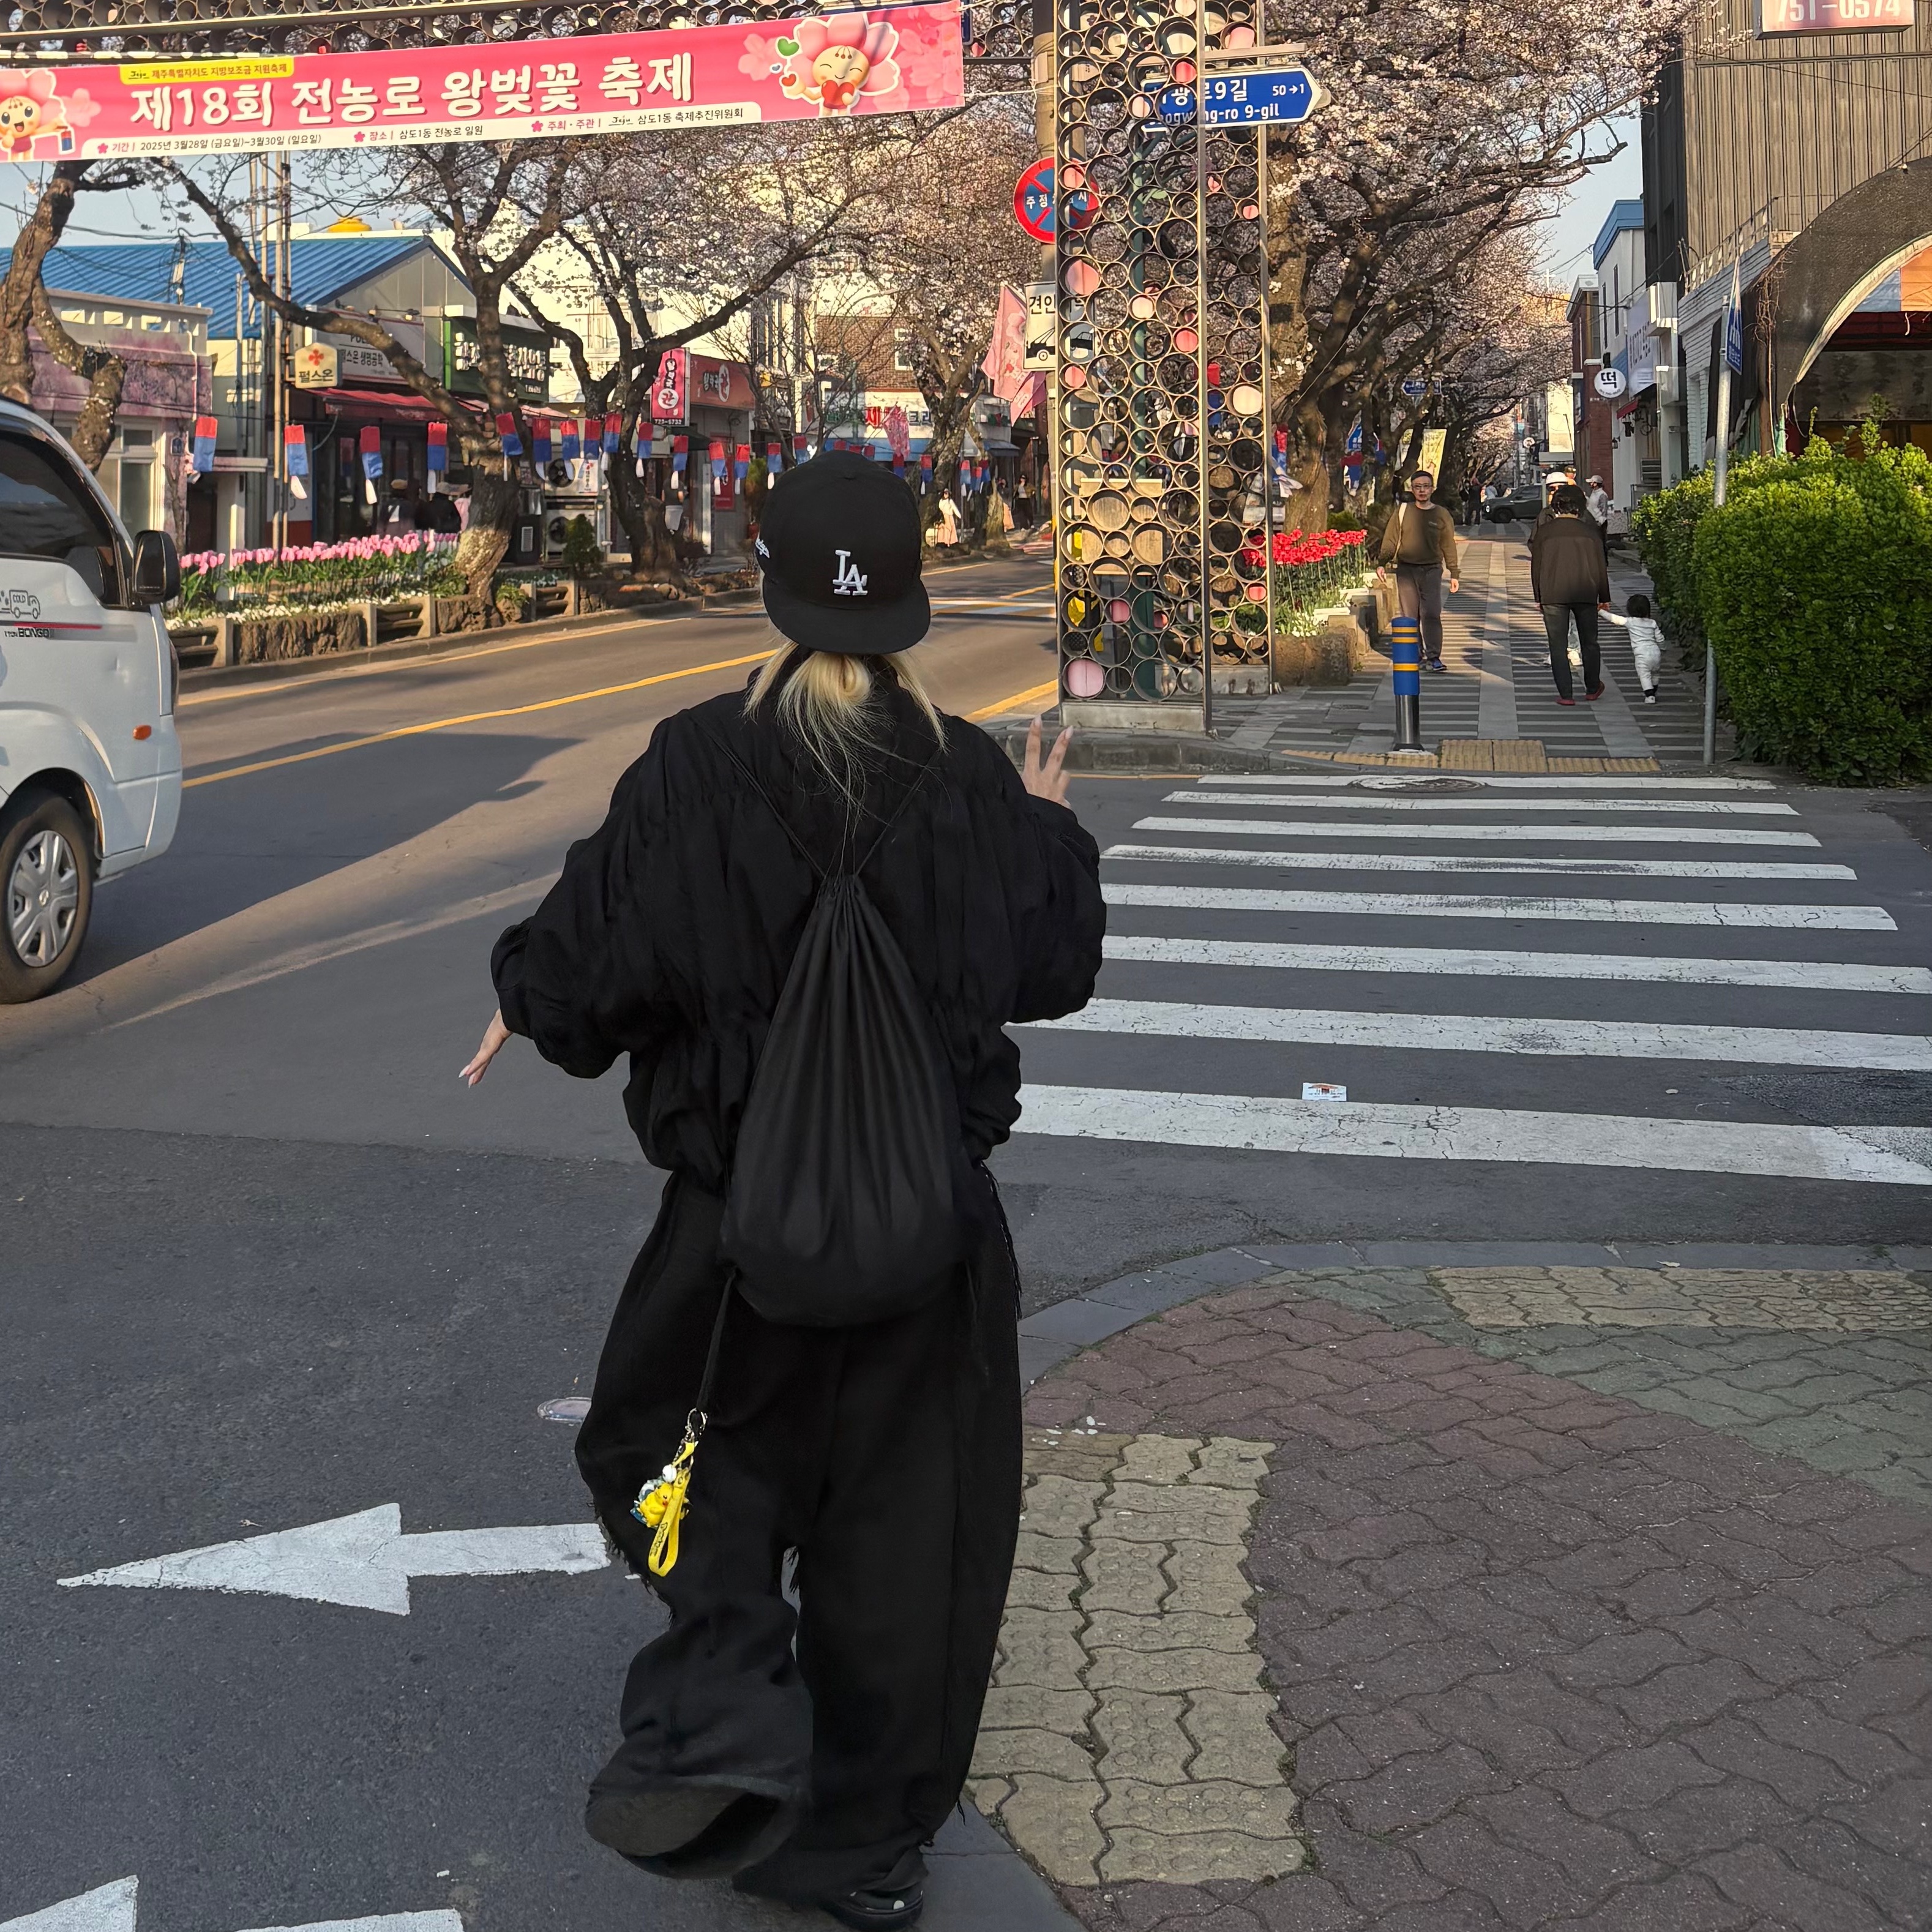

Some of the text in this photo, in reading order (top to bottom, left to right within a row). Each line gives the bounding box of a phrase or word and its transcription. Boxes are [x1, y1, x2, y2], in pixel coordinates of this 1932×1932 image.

[152, 67, 208, 78] 제주특별자치도
[211, 65, 251, 76] 지방보조금
[254, 63, 287, 75] 지원축제
[130, 53, 692, 132] 제18회 전농로 왕벚꽃 축제
[1272, 84, 1286, 96] 50
[1299, 83, 1305, 94] 1
[547, 119, 566, 131] 주최
[575, 118, 596, 129] 주관
[637, 113, 672, 125] 삼도1동
[675, 108, 744, 122] 축제추진위원회
[1245, 103, 1279, 119] 9-gil
[369, 124, 483, 141] 장소 삼도1동 전농로 일원
[111, 143, 129, 152] 기간
[140, 141, 171, 151] 2025년
[174, 140, 208, 151] 3월28일
[288, 134, 321, 146] (일요일)
[299, 369, 334, 383] 펄스온
[1601, 371, 1617, 389] 떡
[833, 549, 868, 596] LA
[18, 627, 50, 638] BONGO
